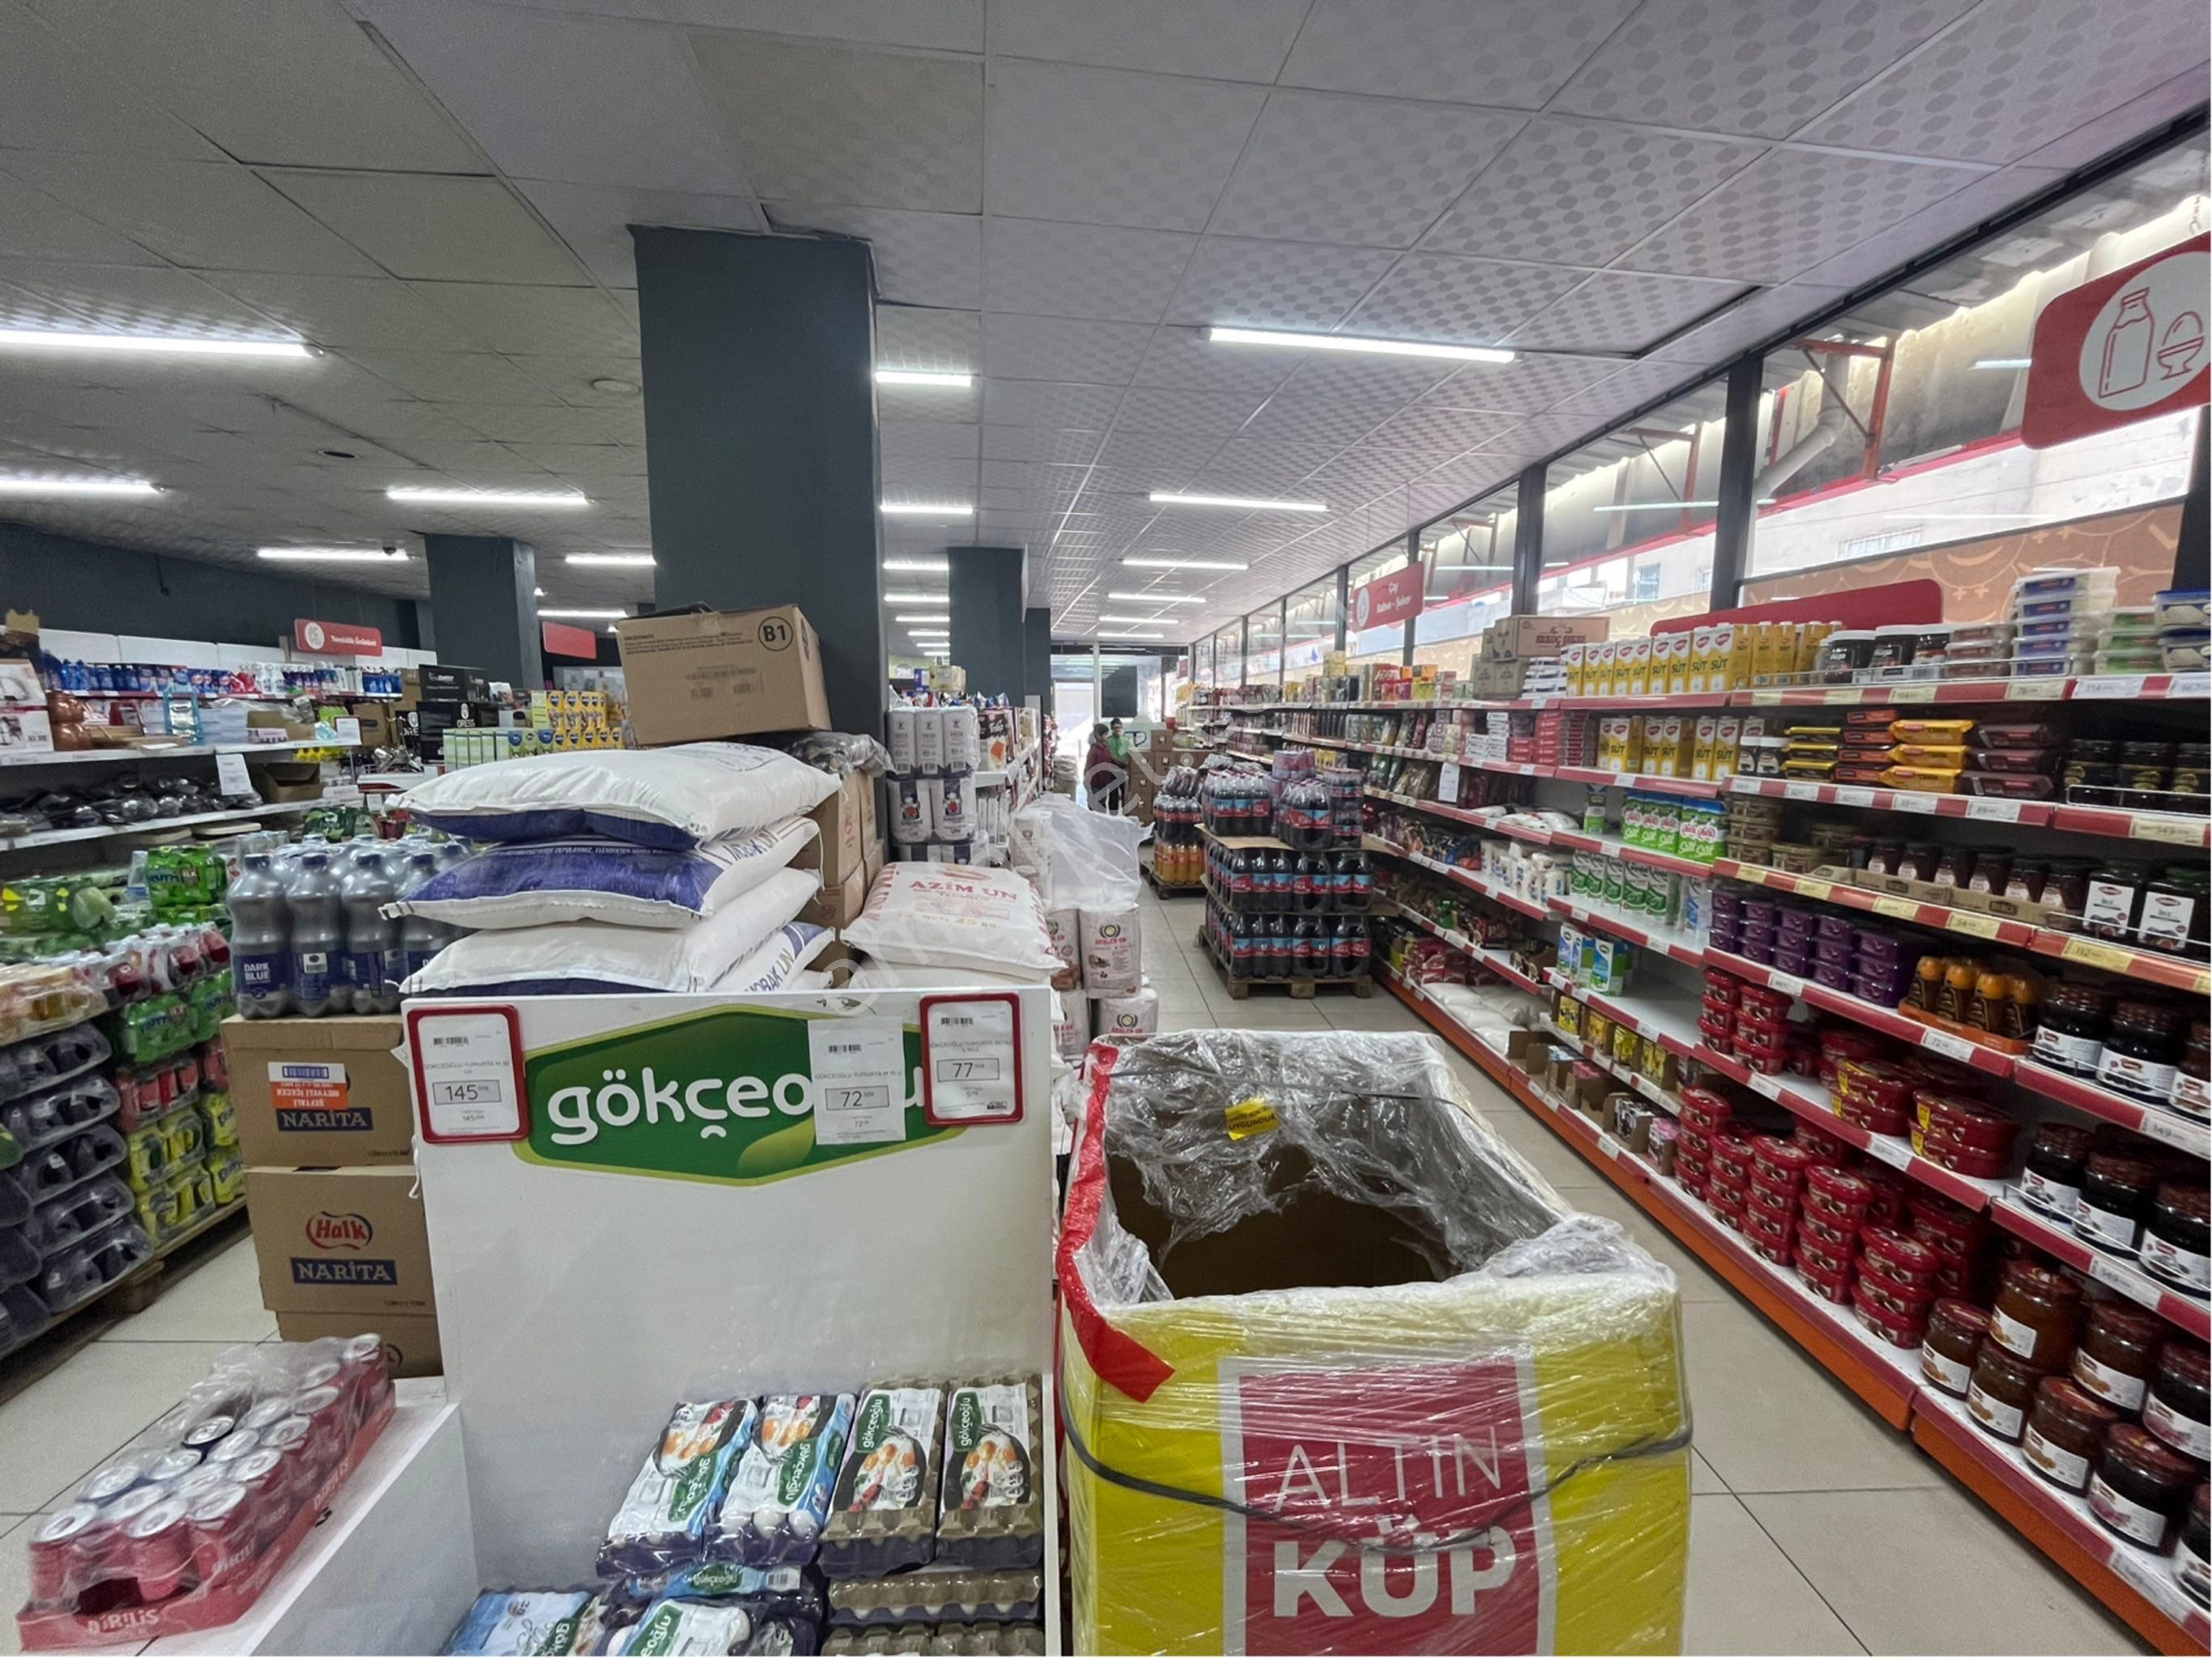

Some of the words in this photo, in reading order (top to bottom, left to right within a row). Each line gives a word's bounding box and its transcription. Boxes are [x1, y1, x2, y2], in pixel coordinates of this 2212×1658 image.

[763, 625, 787, 642] B1
[1611, 743, 1625, 754] SÜT
[1644, 744, 1659, 756] SÜT
[1662, 744, 1676, 756] SÜT
[1695, 746, 1711, 759] SÜT
[1716, 747, 1734, 760] SÜT
[910, 880, 974, 893] AZİM
[982, 888, 1017, 901] UN
[244, 963, 270, 972] DARK
[776, 948, 795, 975] UN
[245, 972, 270, 981] BLUE
[953, 1062, 974, 1078] 77
[445, 1084, 478, 1101] 145
[841, 1090, 863, 1108] 72
[547, 1066, 923, 1146] gökçeou
[282, 1110, 368, 1128] NARİTA
[315, 1219, 367, 1240] Halk
[297, 1262, 392, 1282] NARİTA
[863, 1398, 883, 1448] gökçeoğlu
[961, 1397, 971, 1446] gökçeoğlu
[1272, 1426, 1501, 1513] ALTIN
[1273, 1513, 1517, 1618] KÜP
